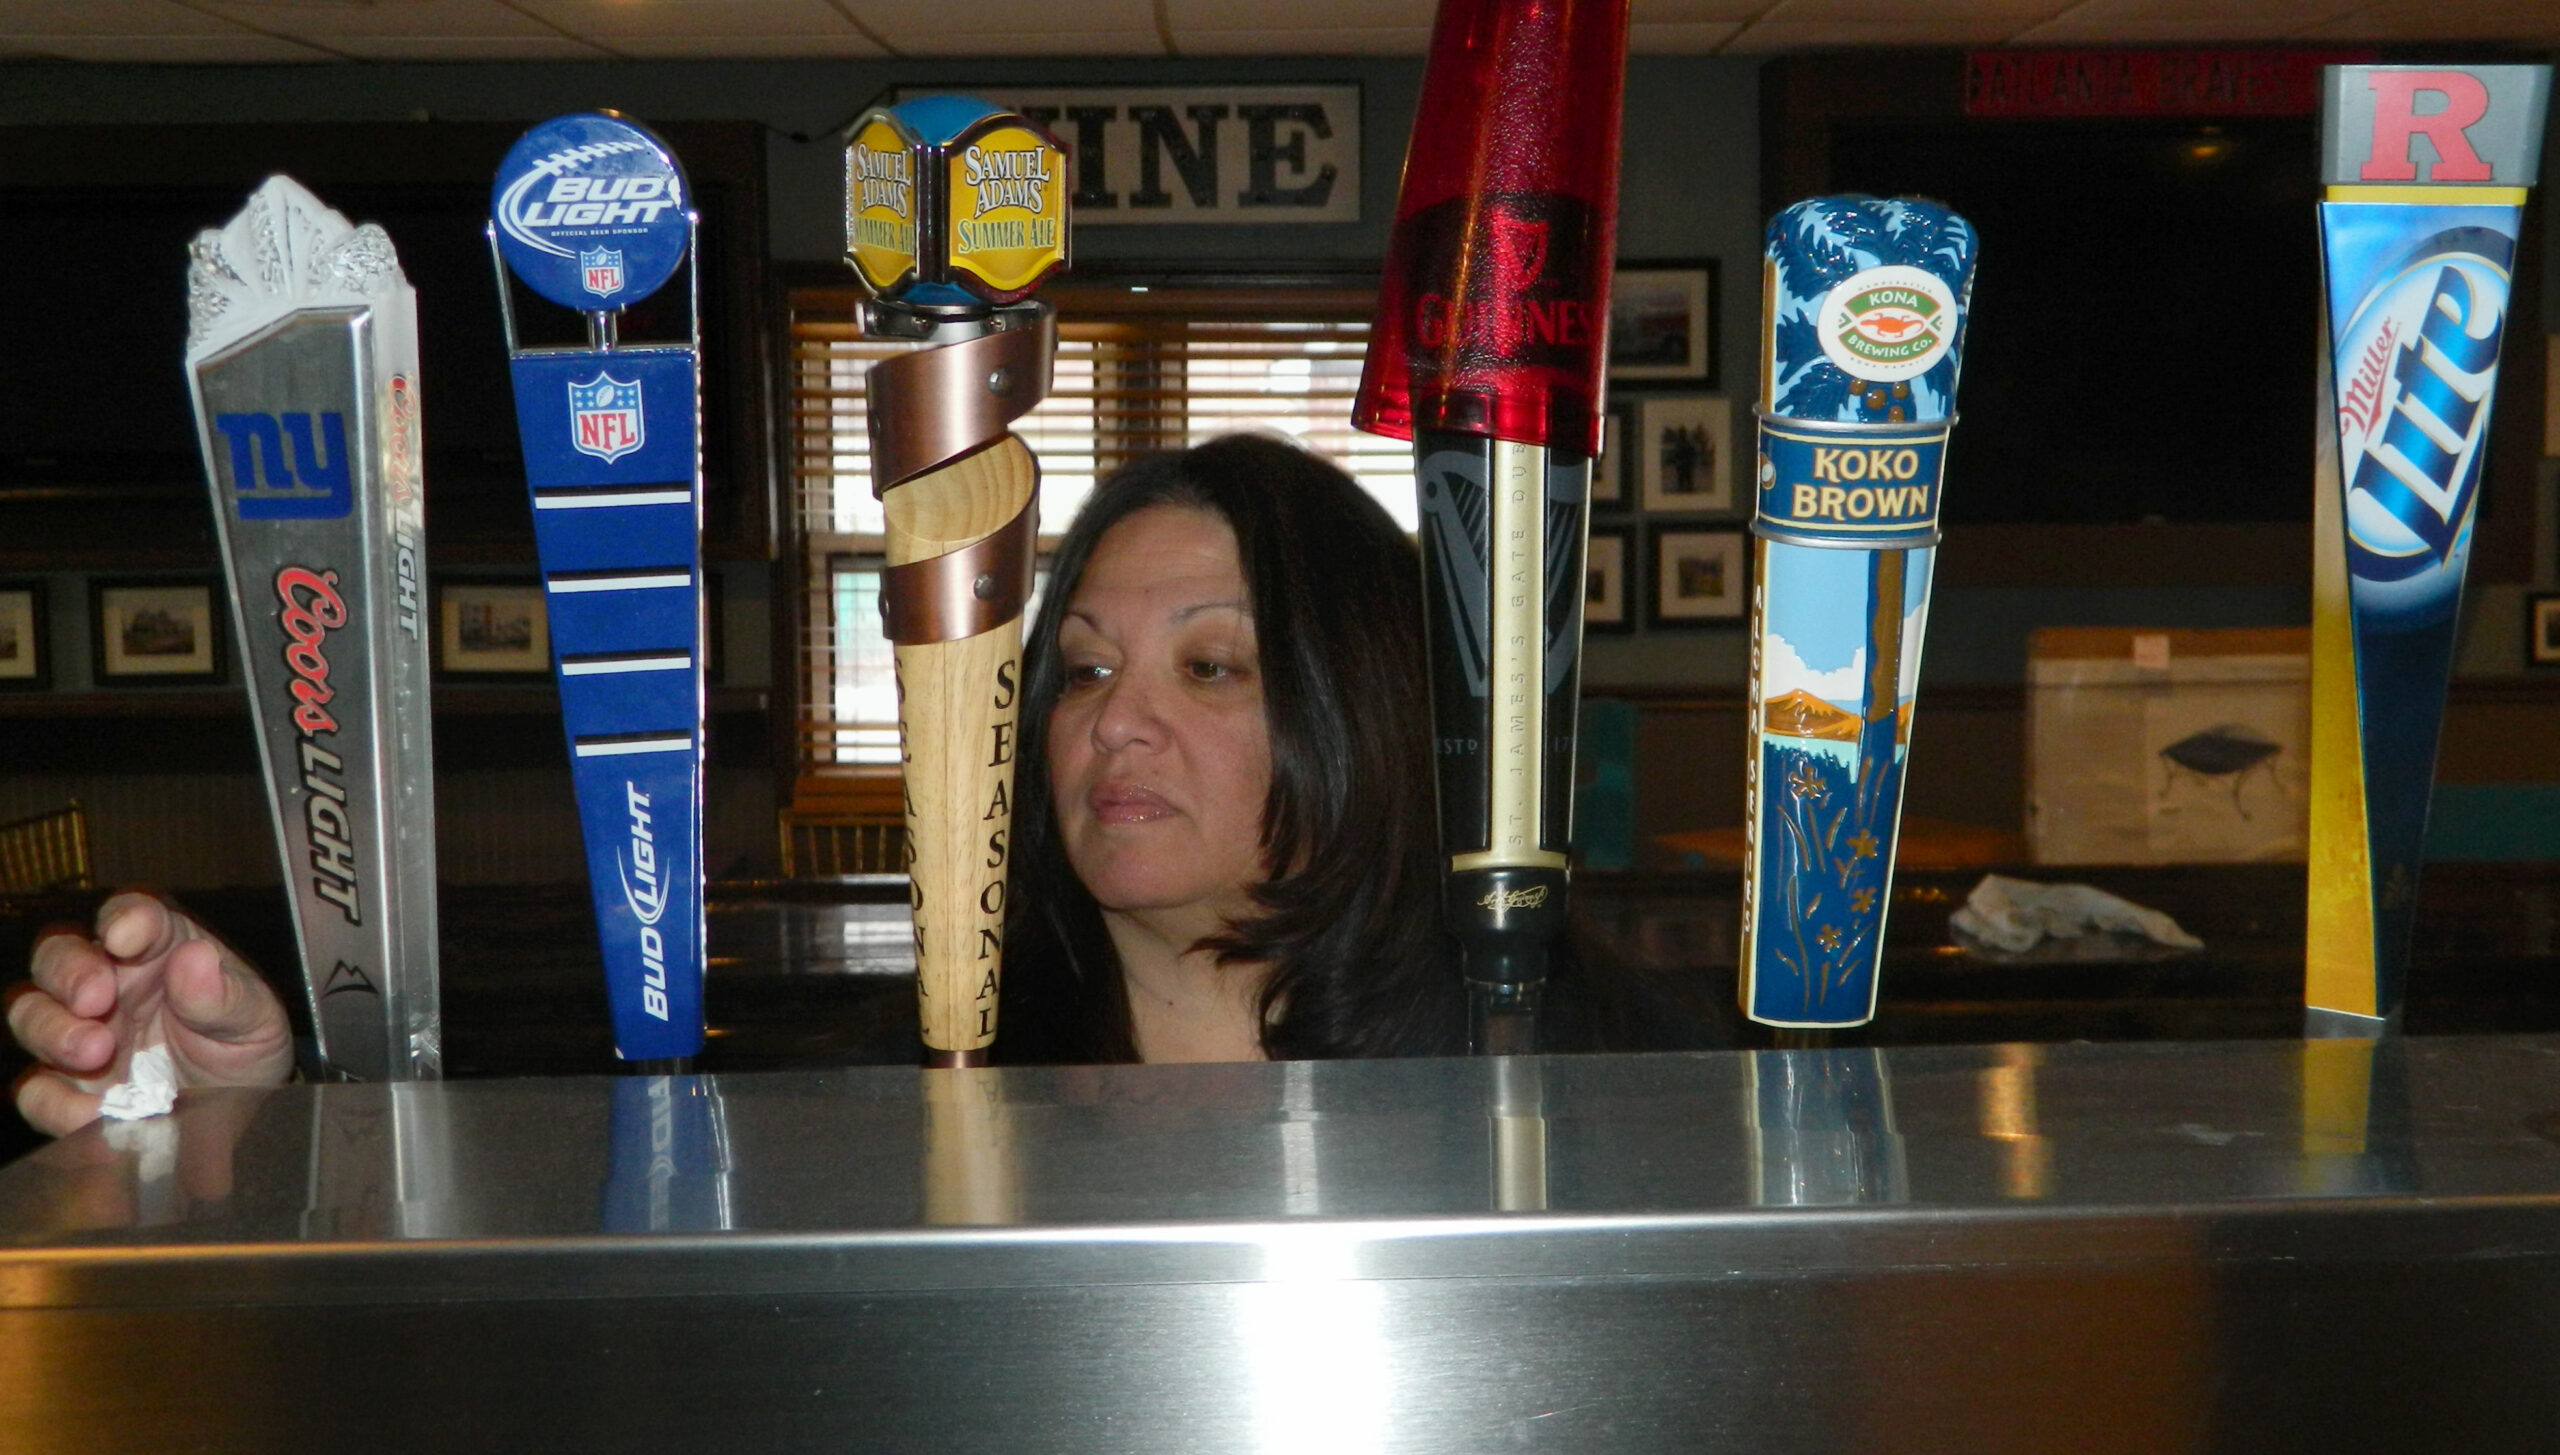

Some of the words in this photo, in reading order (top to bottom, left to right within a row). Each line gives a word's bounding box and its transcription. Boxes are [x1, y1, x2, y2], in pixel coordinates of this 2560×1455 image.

[2360, 70, 2493, 181] R
[857, 143, 912, 187] SAMUEL
[964, 145, 1050, 186] SAMUEL
[1022, 104, 1338, 208] INE
[521, 201, 677, 227] LIGHT
[546, 177, 666, 202] BUD
[859, 180, 909, 219] ADAMS
[973, 179, 1044, 219] ADAMS
[551, 229, 588, 237] OFFICIAL
[590, 228, 609, 236] BEER
[612, 227, 649, 235] SPONSOR
[957, 218, 1025, 254] SUMMER
[1025, 217, 1056, 248] ALE
[587, 267, 620, 290] NFL
[1869, 290, 1918, 308] KONA
[1847, 335, 1909, 358] BREWING
[2338, 316, 2401, 442] Miller
[579, 412, 636, 450] NFL
[2350, 265, 2506, 571] Lite
[1512, 442, 1527, 505] DUB
[1813, 447, 1920, 484] KOKO
[1791, 484, 1929, 521] BROWN
[394, 507, 419, 641] LIGHT
[1511, 529, 1526, 608] GATE
[278, 564, 347, 738] Coors
[1749, 583, 1763, 734] ALOHA
[302, 742, 363, 927] LIGHT
[626, 780, 657, 910] LIGHT
[976, 658, 1017, 1038] SEASONAL
[1743, 758, 1757, 934] SERIES
[640, 926, 669, 1022] BUD
